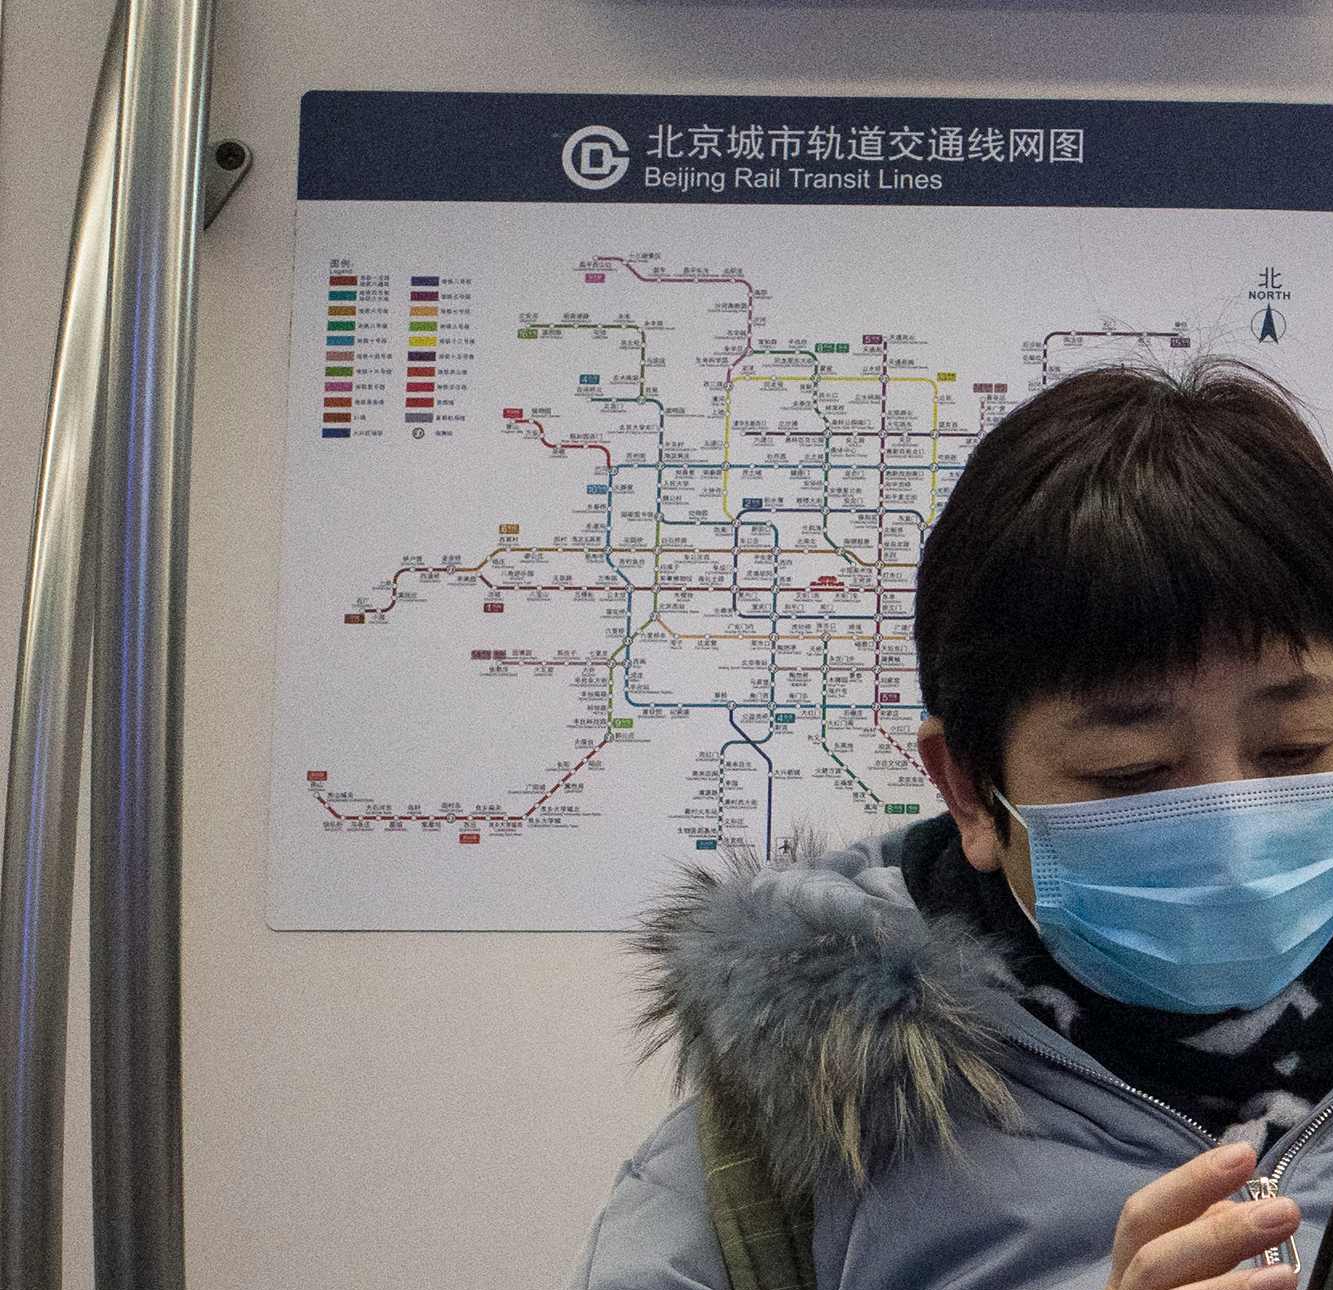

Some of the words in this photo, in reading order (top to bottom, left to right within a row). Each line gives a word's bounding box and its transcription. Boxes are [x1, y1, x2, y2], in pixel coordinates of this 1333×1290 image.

[646, 124, 1084, 164] 北京城市轨道交通线网图
[644, 166, 725, 192] Beijing
[735, 168, 780, 188] Rail
[788, 168, 870, 189] Transit
[879, 169, 943, 189] Lines
[1258, 266, 1282, 289] 北
[1248, 290, 1291, 300] NORTH
